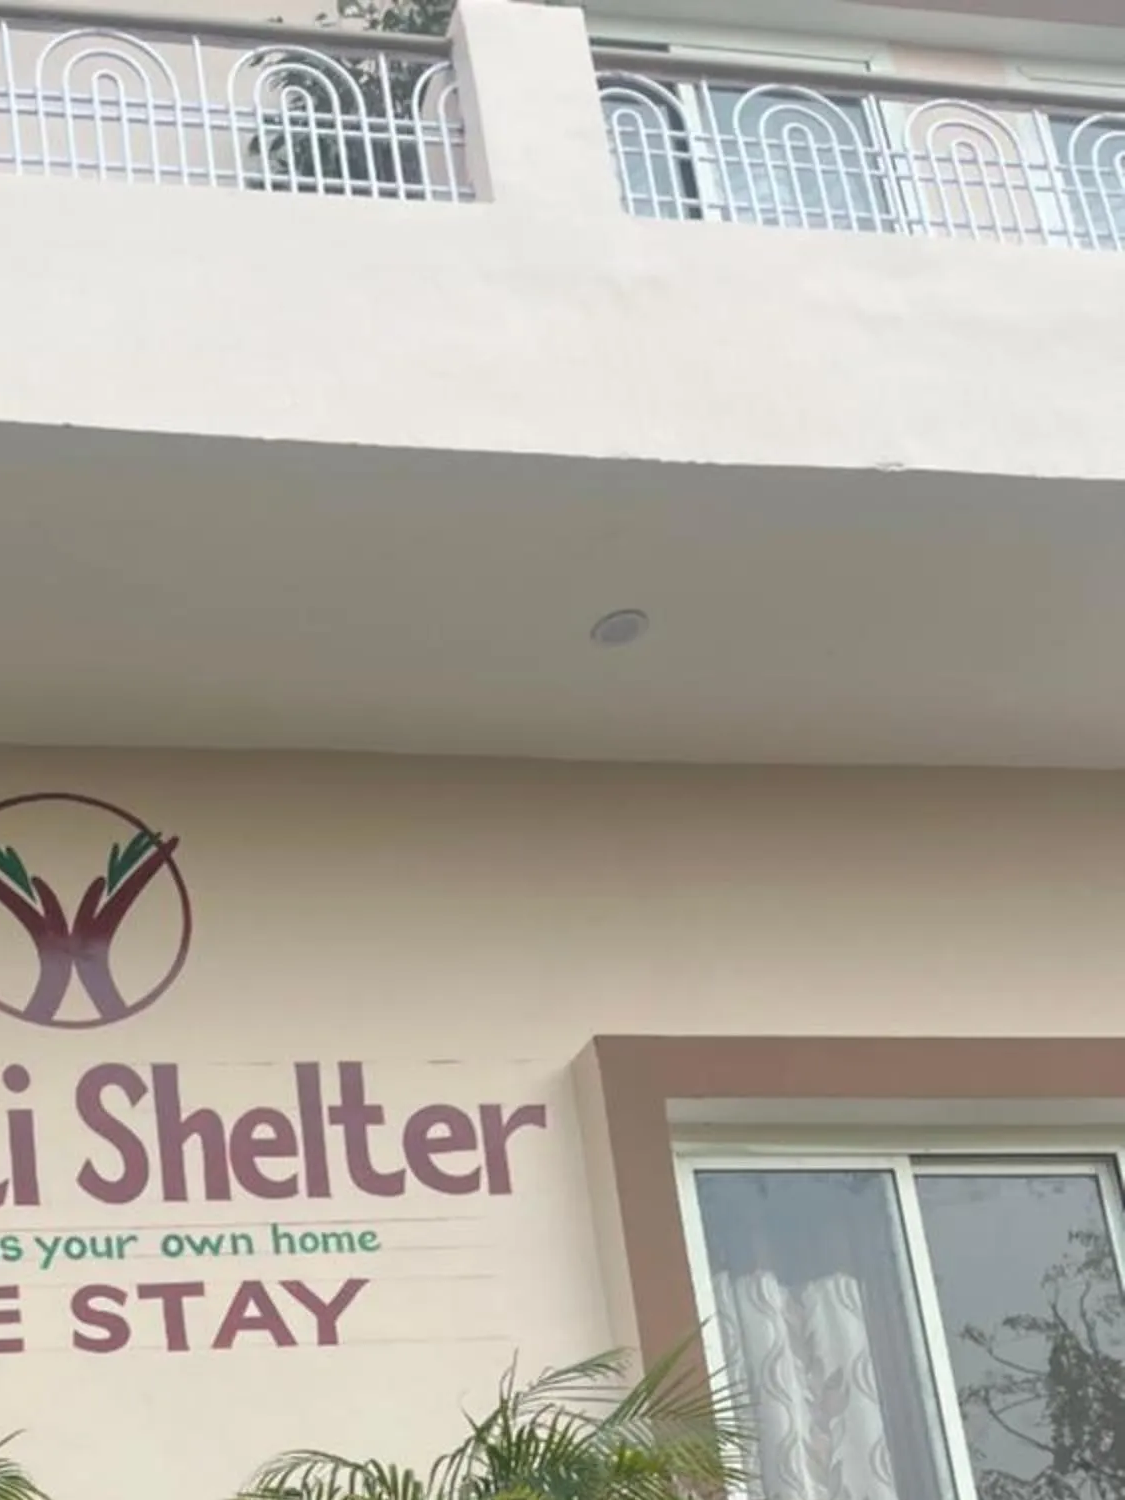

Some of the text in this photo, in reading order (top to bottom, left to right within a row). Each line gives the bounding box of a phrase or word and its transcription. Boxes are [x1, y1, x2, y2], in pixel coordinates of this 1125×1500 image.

[75, 1060, 548, 1205] Shelter
[34, 1235, 138, 1269] your
[161, 1234, 254, 1258] own
[271, 1223, 380, 1255] home
[70, 1278, 370, 1354] STAY
